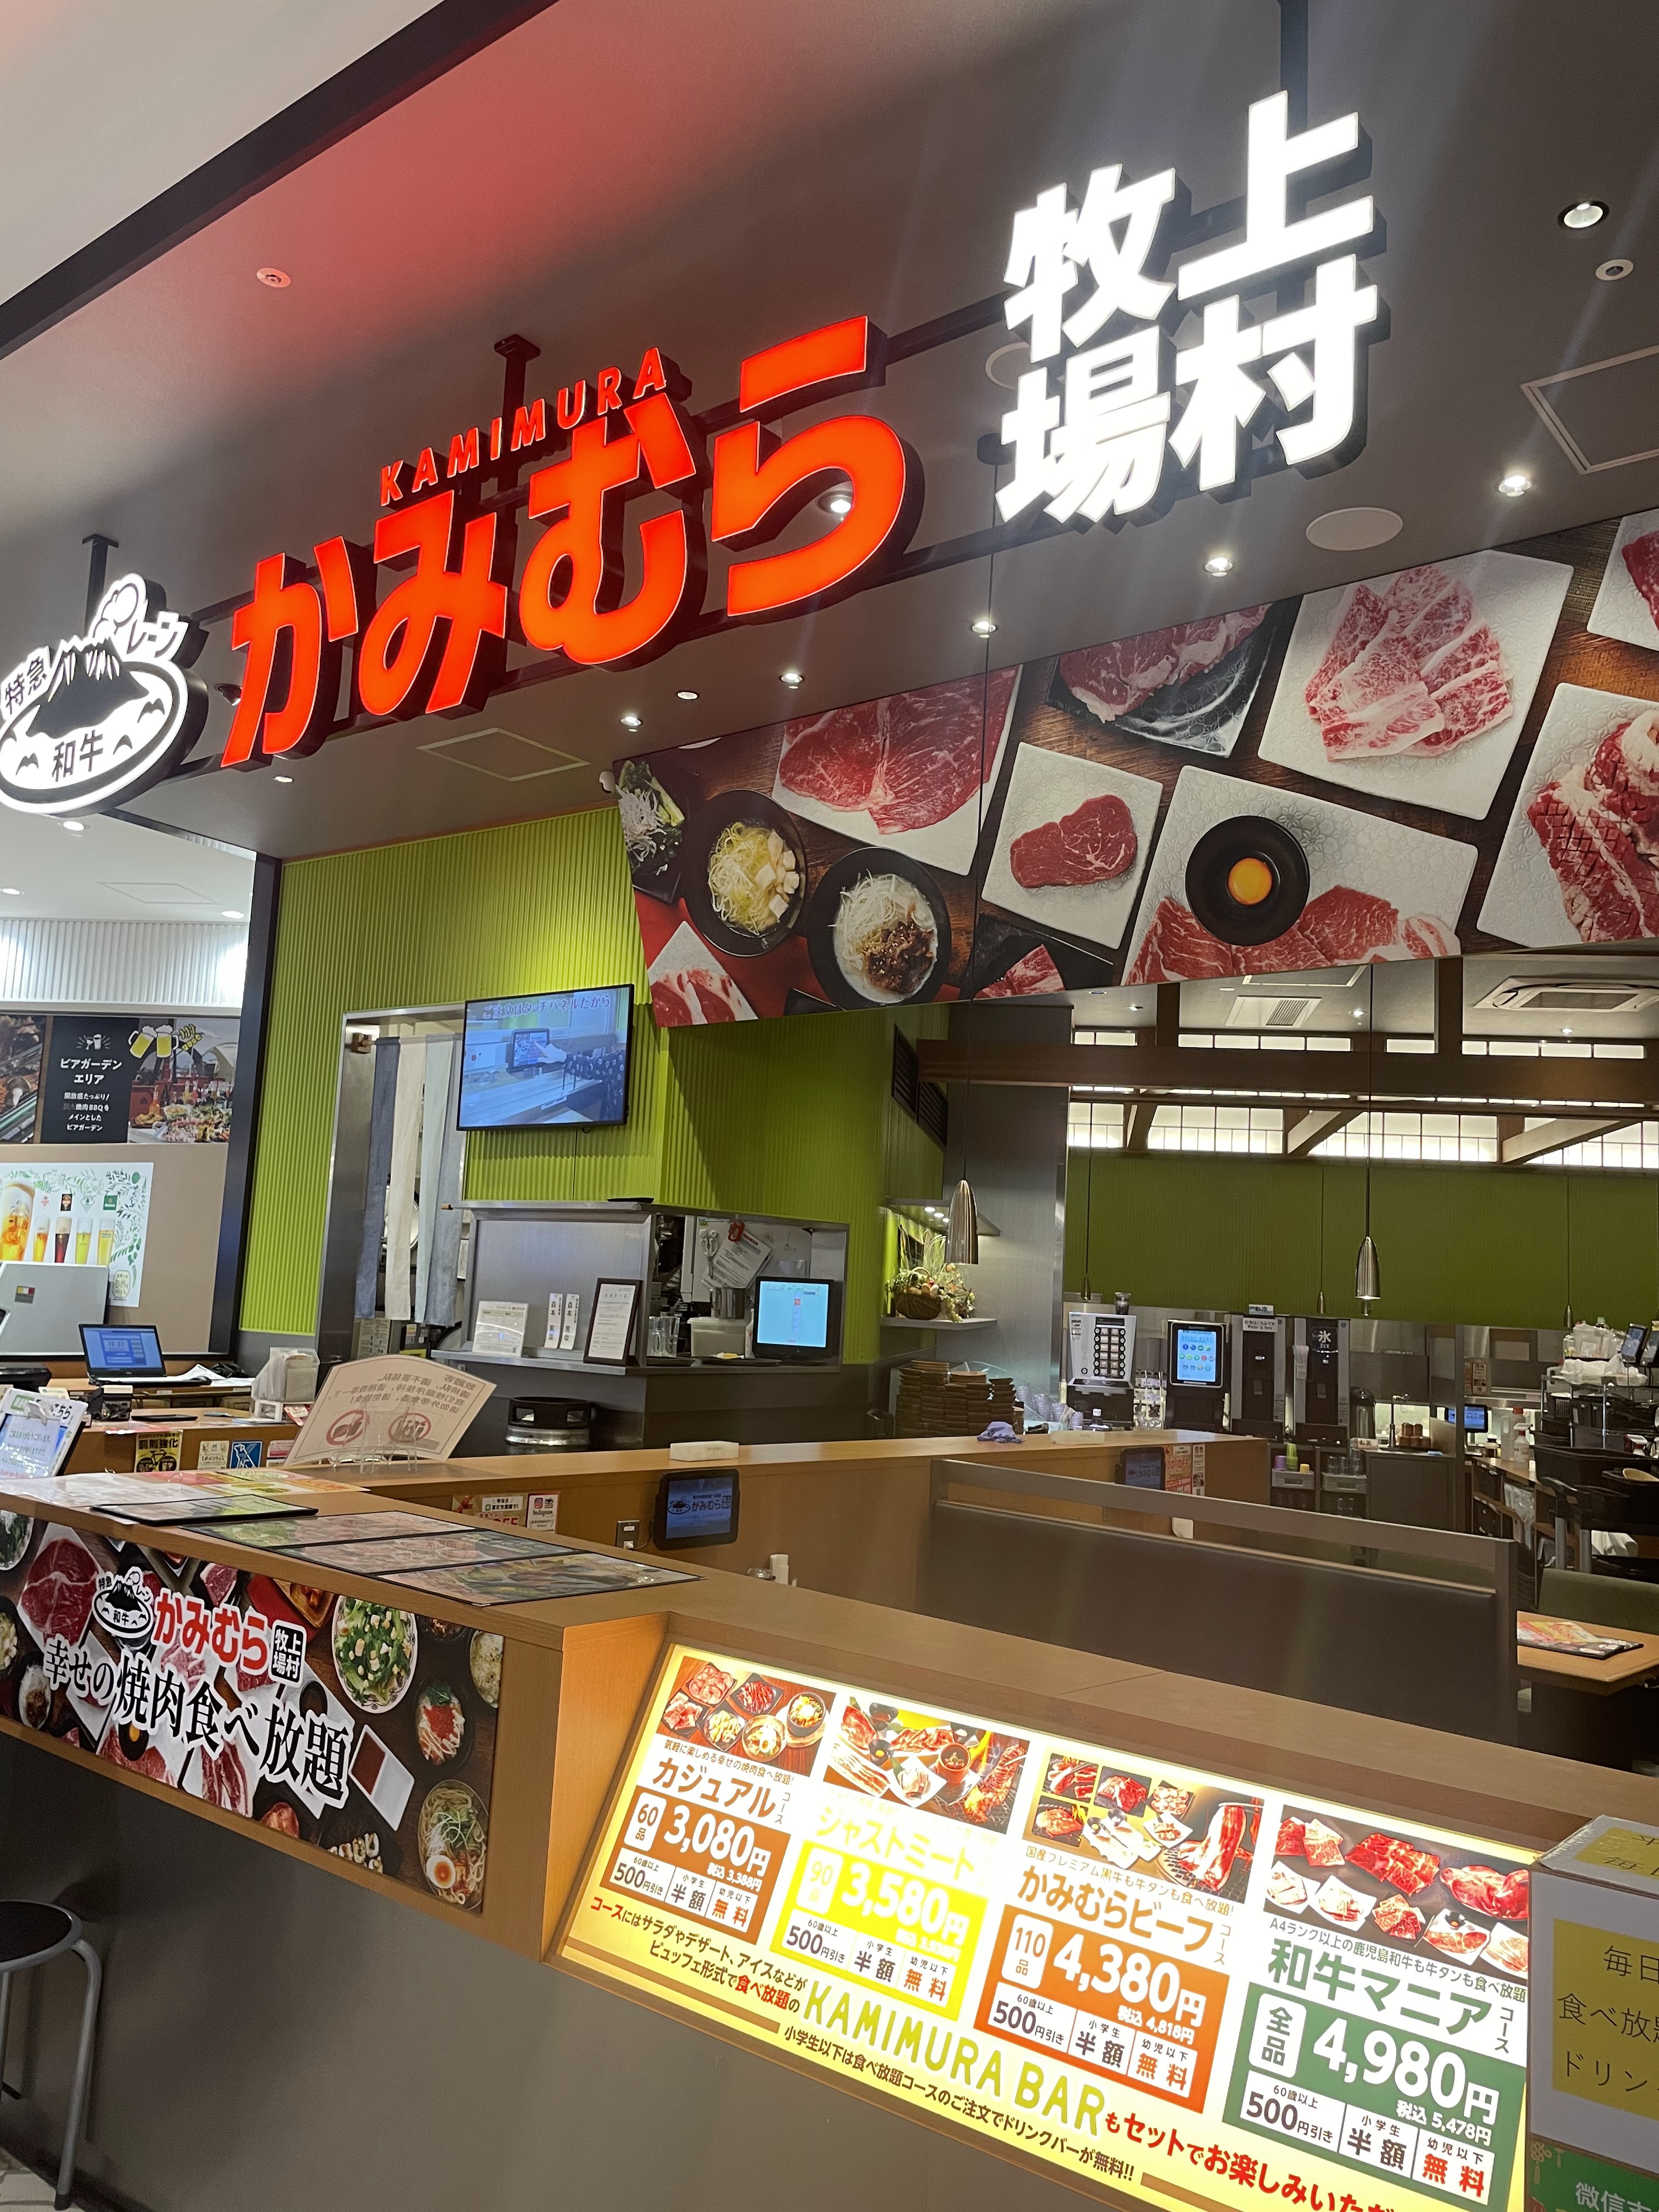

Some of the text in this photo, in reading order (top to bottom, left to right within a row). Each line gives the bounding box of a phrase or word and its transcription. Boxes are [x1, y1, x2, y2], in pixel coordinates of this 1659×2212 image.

[1169, 89, 1378, 490] 上村
[995, 163, 1176, 523] 牧場
[380, 347, 665, 505] KAMIMURA
[222, 315, 905, 768] かみむら
[126, 618, 178, 658] レーン
[4, 654, 48, 710] 特急
[51, 729, 105, 783] 和牛
[482, 994, 611, 1020] ご注文はタッチパネルだから
[60, 1058, 122, 1070] ビアガーデン
[74, 1074, 104, 1085] エリア
[66, 1123, 103, 1131] ビアガーデン
[1318, 1330, 1331, 1343] 氷
[98, 1575, 113, 1590] 特急
[112, 1609, 129, 1626] 和牛
[153, 1592, 268, 1671] かみむら
[272, 1628, 289, 1674] 牧場
[284, 1632, 302, 1679] 上村
[44, 1639, 351, 1802] 幸せの焼肉食べ放題
[652, 1757, 777, 1818] カジュアル
[635, 1803, 659, 1842] 60 品
[775, 1792, 793, 1825] コース
[663, 1804, 771, 1877] 3,080円
[816, 1805, 975, 1882] ジャストミート
[612, 1863, 664, 1897] 500円引き
[670, 1884, 705, 1912] 半額
[682, 1873, 705, 1889] 小学生
[718, 1887, 751, 1904] 幼児以下
[710, 1899, 748, 1926] 無料
[841, 1861, 970, 1946] 3,580円
[1017, 1865, 1214, 1953] かみむらビーフ
[590, 1896, 807, 1992] コースにはサラダやデザート、アイスなどが
[786, 1925, 846, 1964] 500円引き
[866, 1939, 894, 1956] 小学生
[1015, 1927, 1046, 1976] 110 品
[1213, 1923, 1232, 1966] コース
[854, 1950, 895, 1983] 半額
[903, 1968, 947, 2002] 無料
[909, 1955, 949, 1976] 幼児以下
[1053, 1933, 1207, 2028] 4,380円
[1603, 1945, 1659, 1985] 毎日
[1017, 1993, 1054, 2016] 60歳以上
[1267, 1938, 1493, 2035] 和牛マニア
[648, 1939, 801, 2013] ビュッフェ形式で食べ放題の
[803, 1979, 1002, 2098] KAMIMURA
[1014, 2061, 1106, 2137] BAR
[992, 2000, 1065, 2045] 500円引き
[1088, 2019, 1120, 2039] 小学生
[1117, 2005, 1195, 2046] 税込 4,818円
[1261, 2006, 1294, 2067] 全品
[1494, 2006, 1514, 2054] コース
[1556, 1993, 1659, 2044] 食べ放
[1075, 2032, 1126, 2069] 半額
[1141, 2038, 1189, 2062] 幼児以下
[1135, 2053, 1187, 2091] 無料
[1312, 2017, 1500, 2126] 4,980円
[1566, 2051, 1659, 2092] ドリン
[1246, 2091, 1334, 2144] 500円引き
[1273, 2085, 1318, 2109] 60歳以上
[1361, 2114, 1401, 2138] 小学生
[1396, 2100, 1492, 2147] 税込 5,478円
[1347, 2127, 1408, 2171] 半額
[1427, 2137, 1484, 2164] 幼児以下
[1421, 2153, 1485, 2198] 無料
